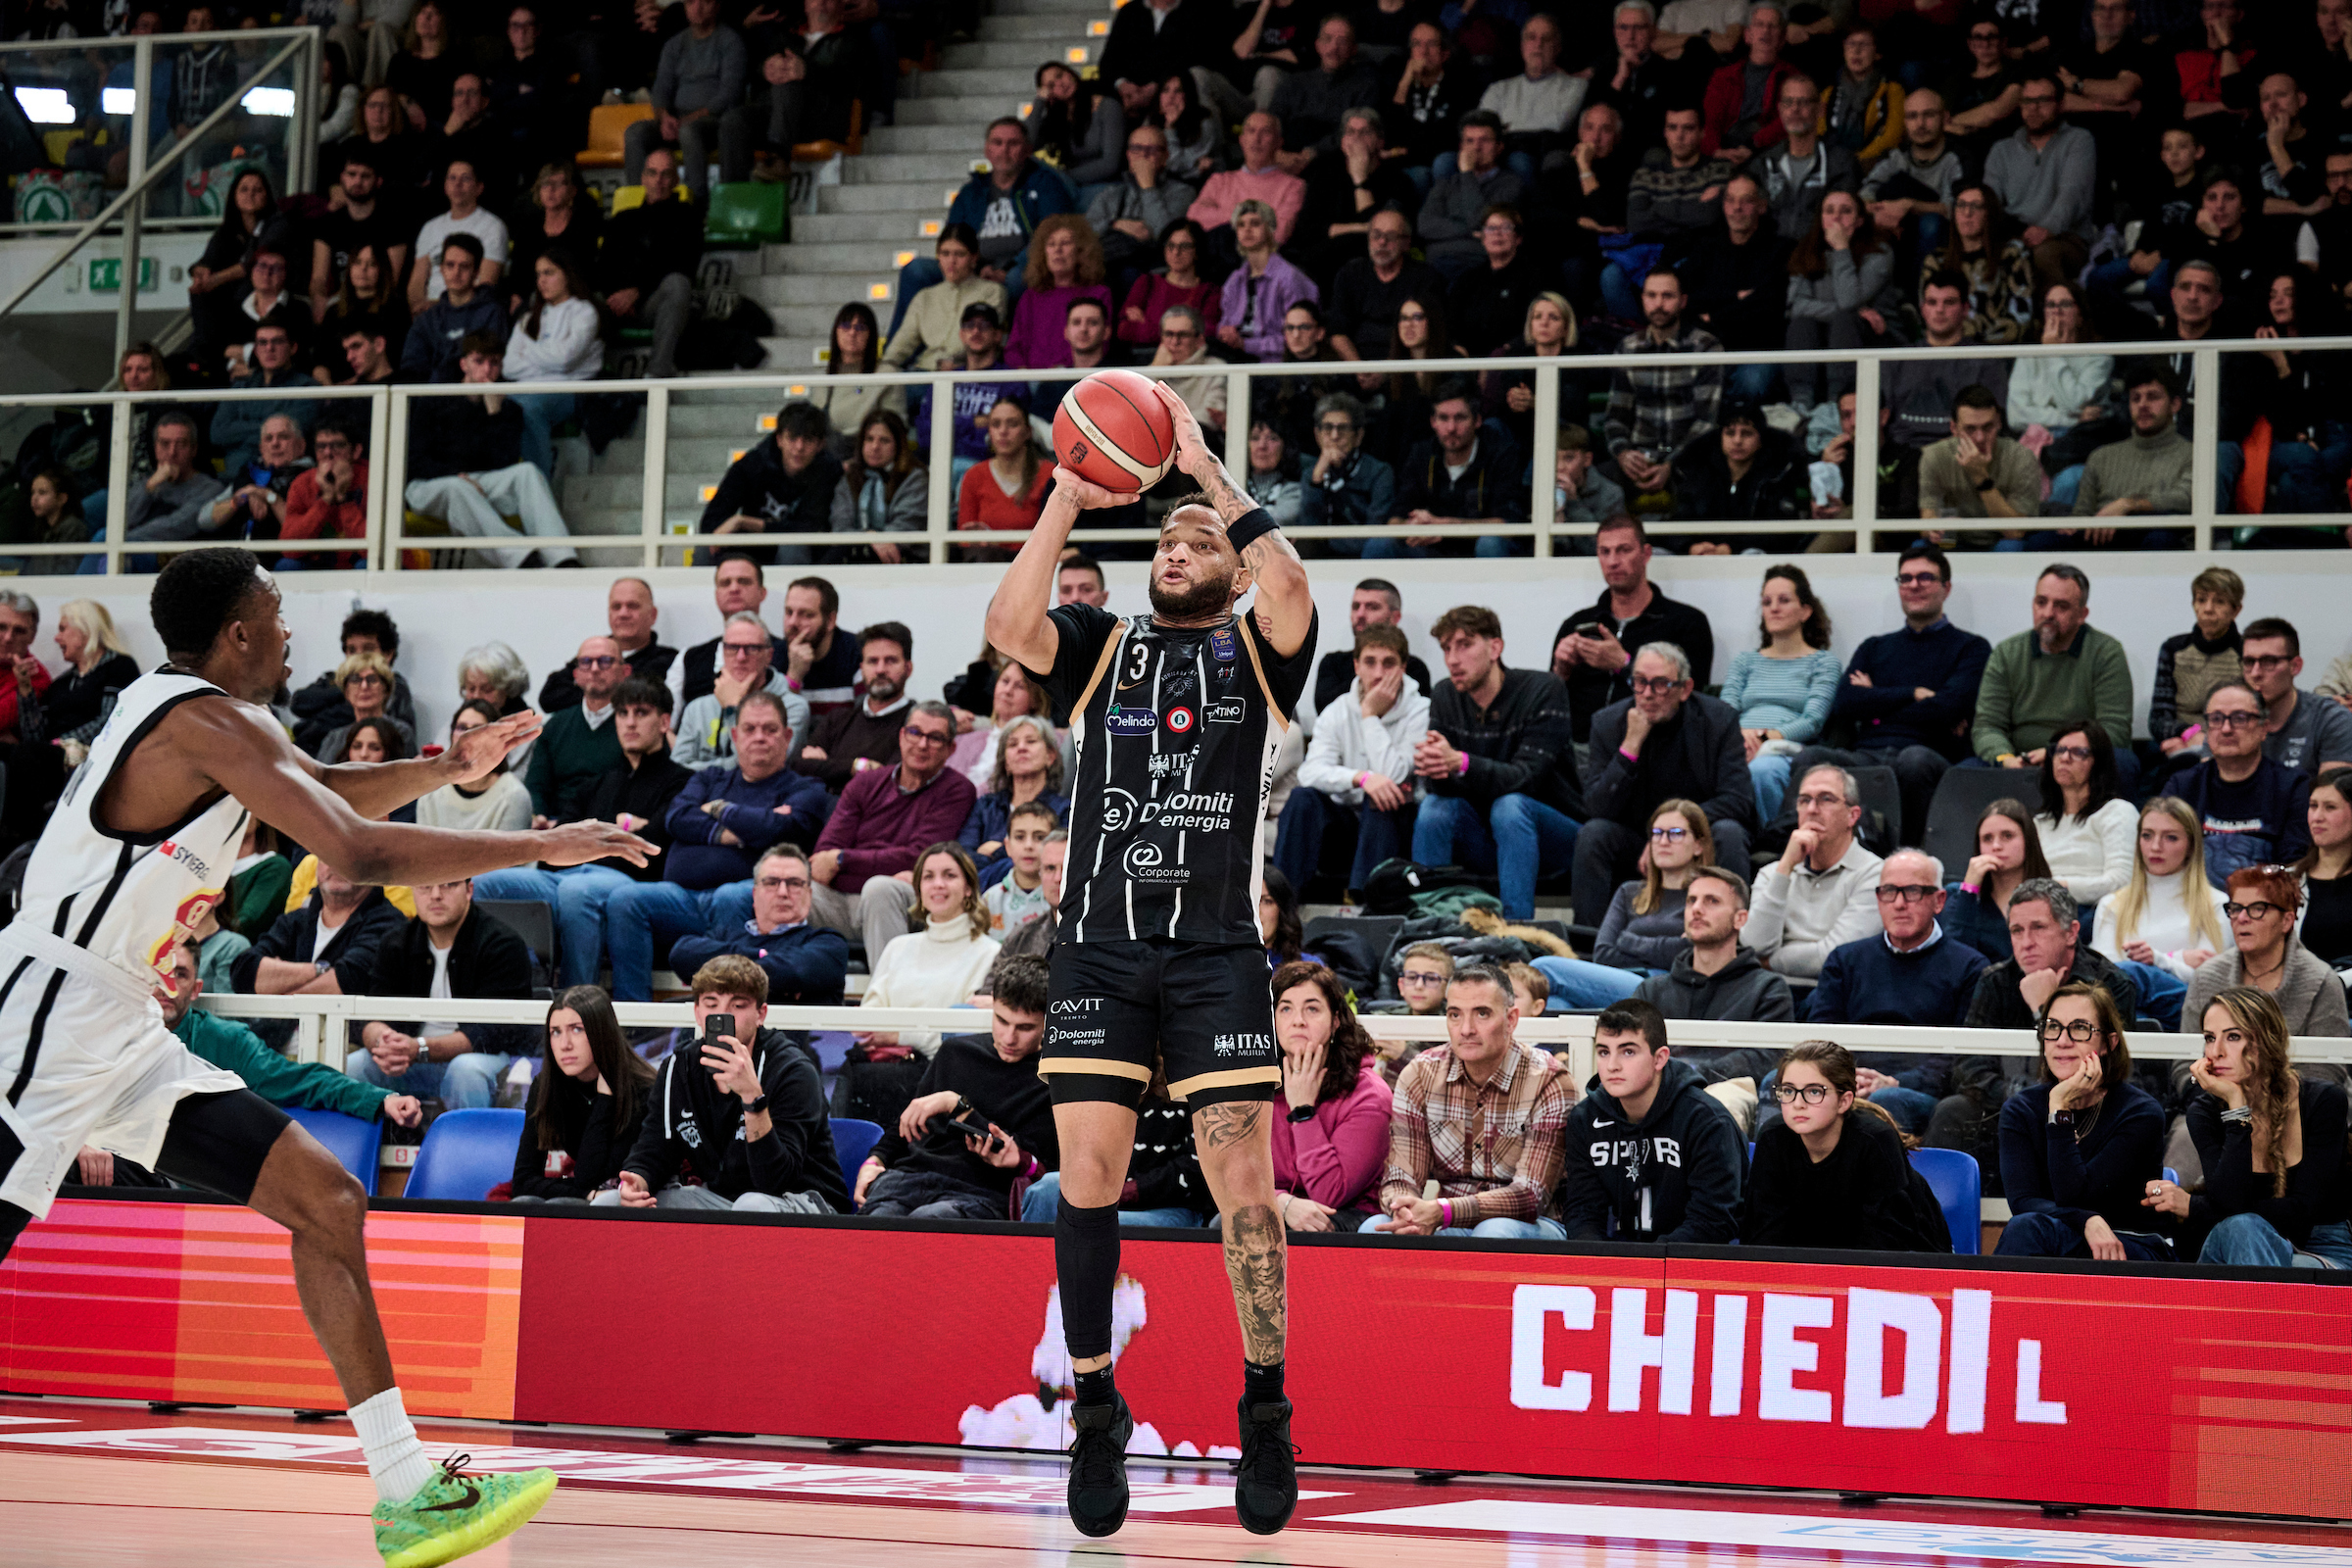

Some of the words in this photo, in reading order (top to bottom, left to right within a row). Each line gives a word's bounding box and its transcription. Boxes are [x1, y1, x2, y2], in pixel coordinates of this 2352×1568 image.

[1129, 643, 1150, 680] 3
[1106, 713, 1155, 727] Melinda
[1158, 813, 1231, 833] energia
[1138, 866, 1191, 879] Corporate
[1050, 998, 1104, 1014] CAVIT
[1058, 1028, 1105, 1040] Dolomiti
[1237, 1033, 1271, 1049] ITAS
[1072, 1038, 1105, 1047] energia
[1509, 1283, 1992, 1435] CHIEDI
